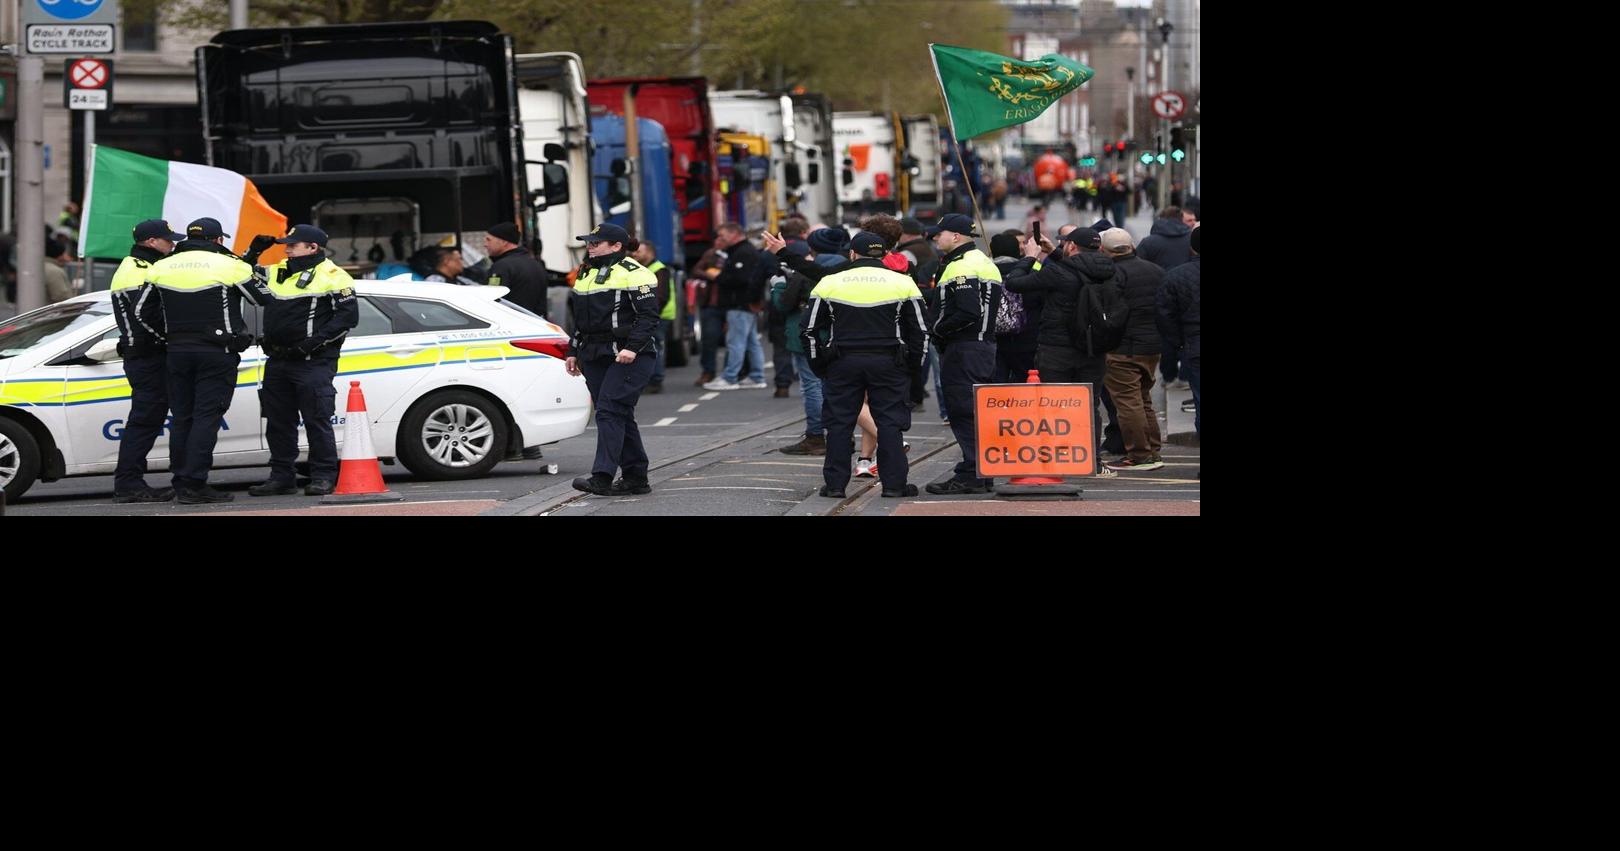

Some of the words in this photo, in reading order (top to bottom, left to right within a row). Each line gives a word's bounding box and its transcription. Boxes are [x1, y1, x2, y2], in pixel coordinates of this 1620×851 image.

[67, 28, 108, 37] Rothar
[32, 40, 68, 48] CYCLE
[71, 40, 108, 48] TRACK
[72, 95, 87, 103] 24
[169, 261, 211, 270] GARDA
[986, 396, 1035, 408] Bothar
[998, 418, 1071, 437] ROAD
[984, 445, 1088, 465] CLOSED
